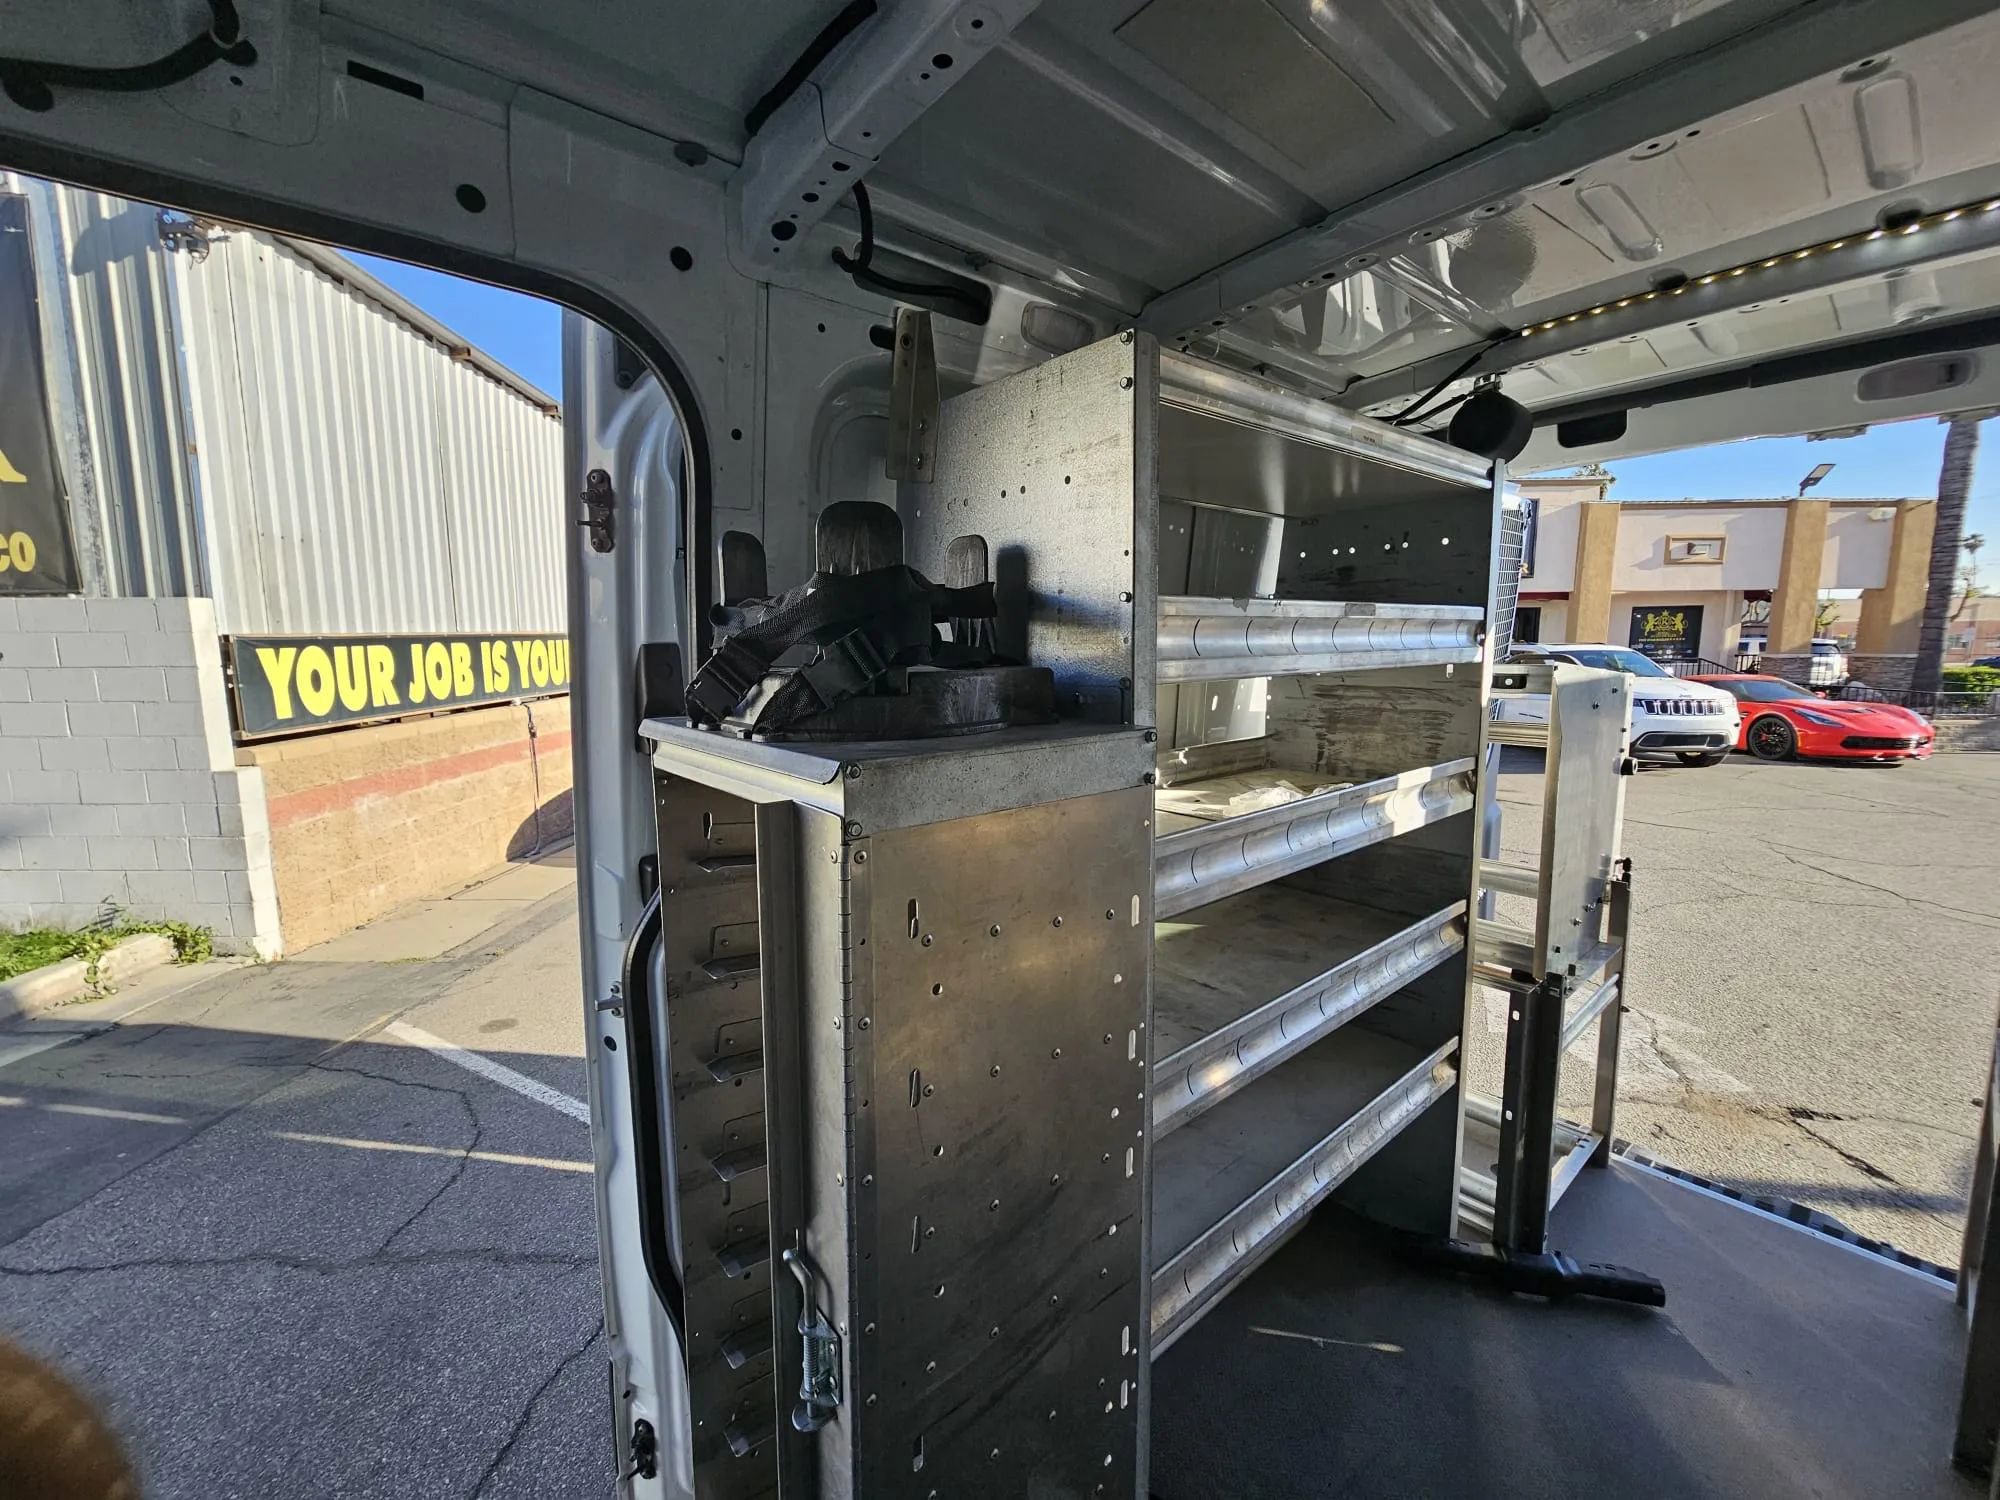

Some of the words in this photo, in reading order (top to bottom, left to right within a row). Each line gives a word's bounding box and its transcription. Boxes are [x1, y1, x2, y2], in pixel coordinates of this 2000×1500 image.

[255, 645, 400, 720] YOUR
[408, 641, 475, 704] JOB
[480, 639, 510, 693] IS
[511, 639, 570, 688] YOU
